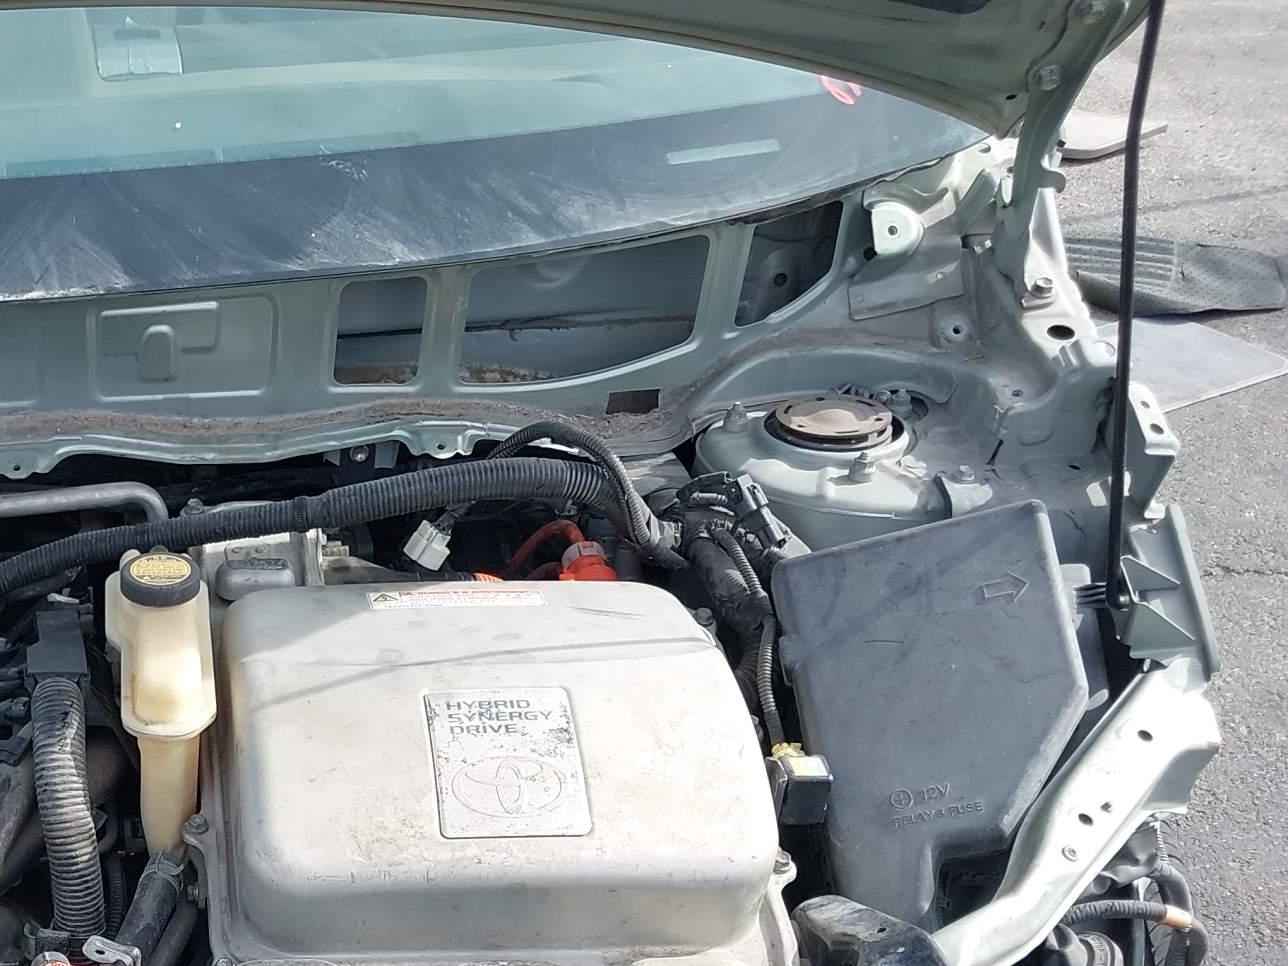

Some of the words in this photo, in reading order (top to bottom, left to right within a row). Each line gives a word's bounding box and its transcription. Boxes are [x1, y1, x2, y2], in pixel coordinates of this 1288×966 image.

[446, 699, 531, 711] HYBRID
[447, 711, 553, 724] SYNERGY
[449, 723, 519, 735] DRIVE
[919, 783, 950, 801] 12V
[892, 809, 936, 828] RELAY
[948, 800, 984, 817] FUSE
